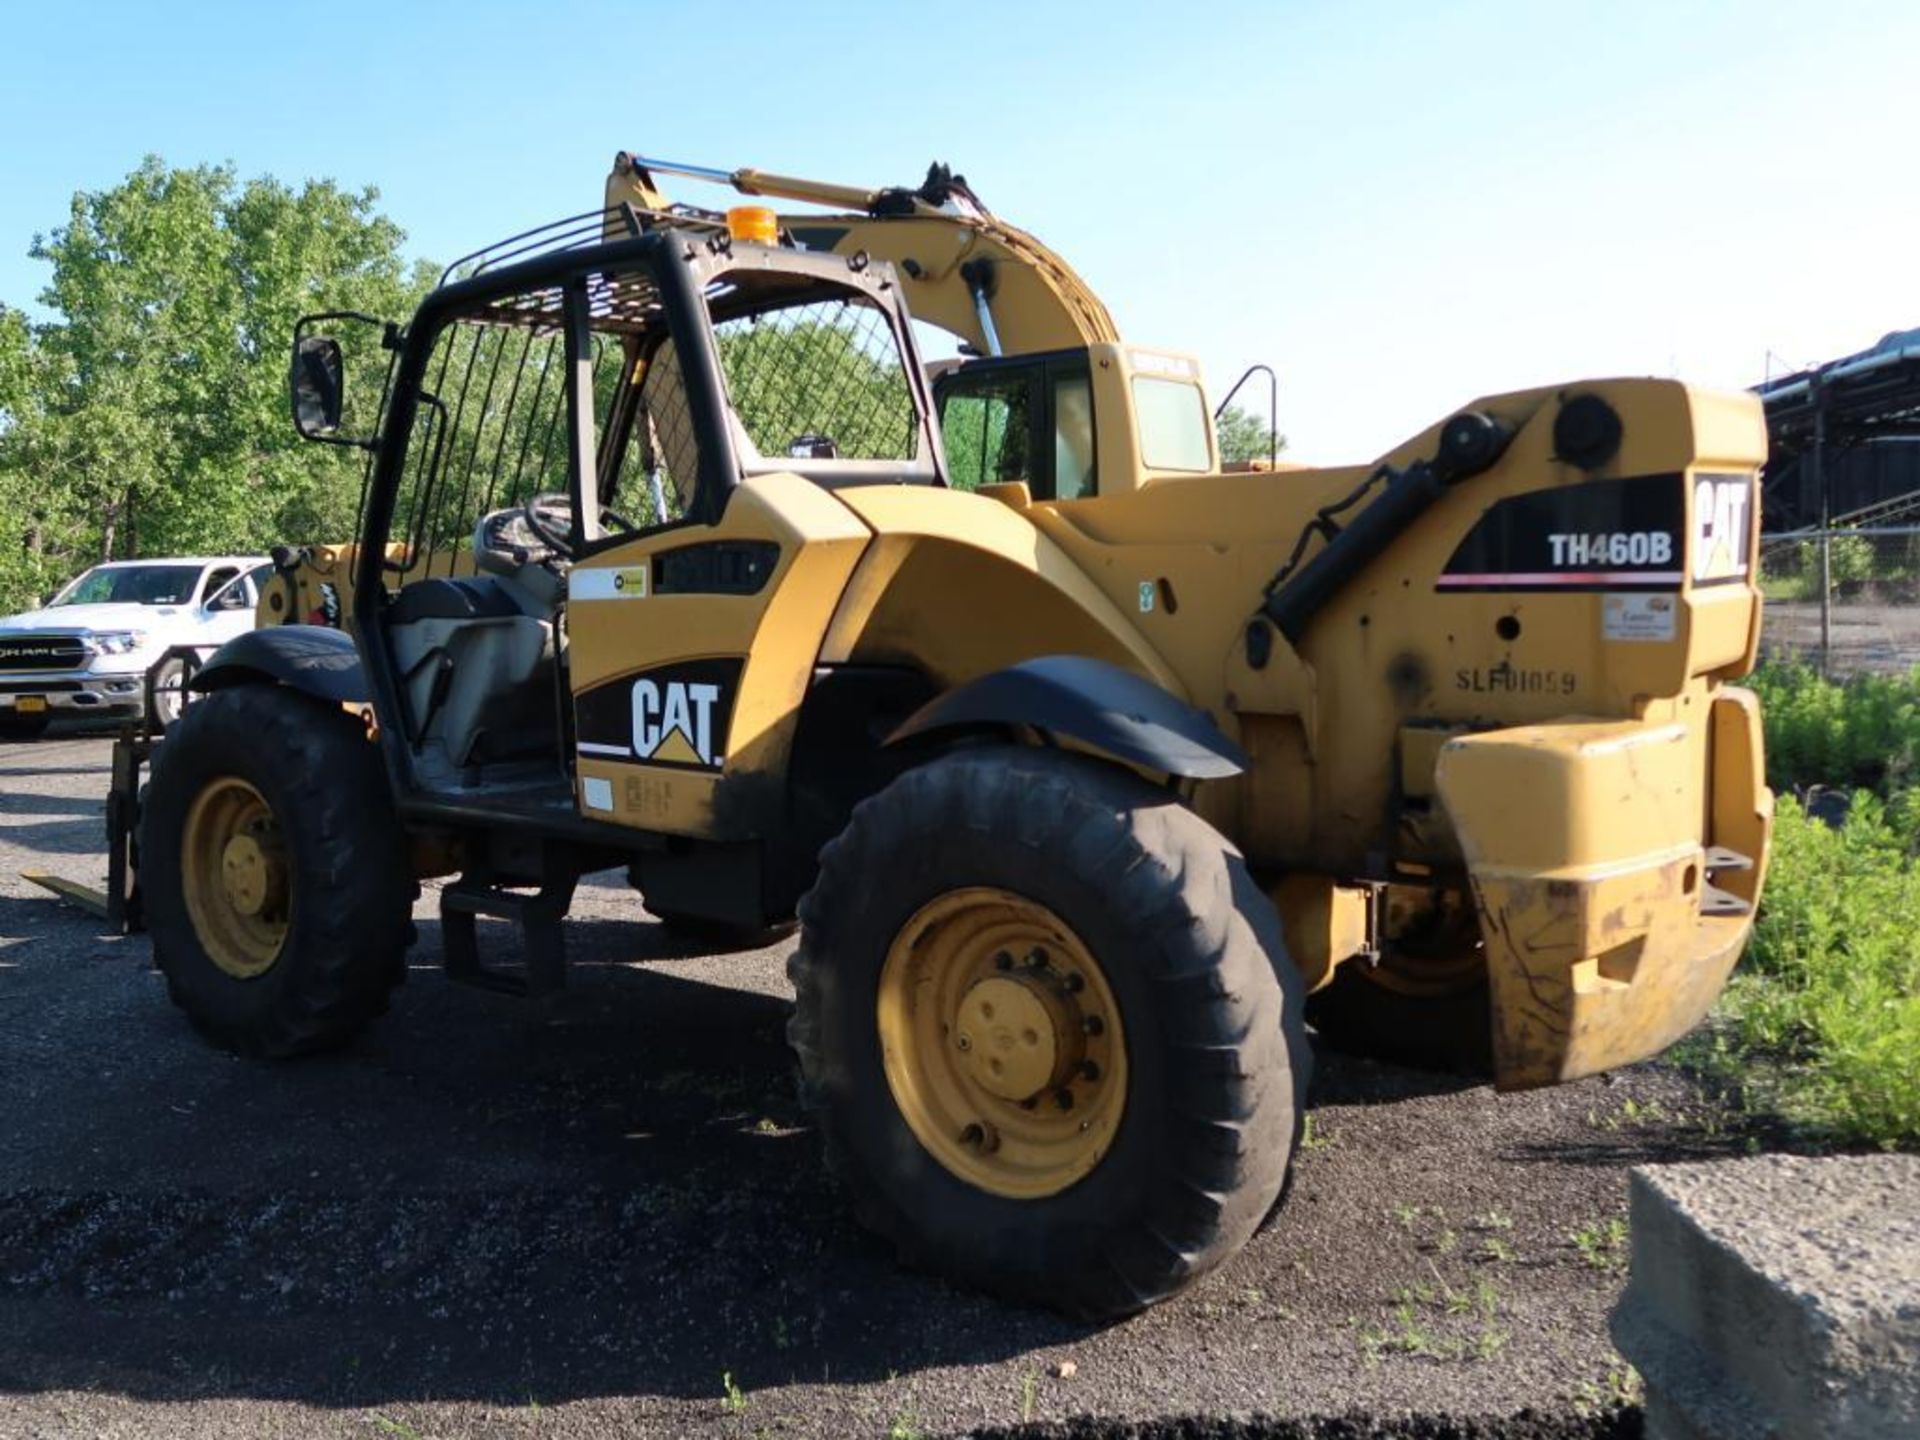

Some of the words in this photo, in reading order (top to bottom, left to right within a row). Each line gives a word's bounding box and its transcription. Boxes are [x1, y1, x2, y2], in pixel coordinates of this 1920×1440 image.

[1549, 531, 1672, 565] TH460B
[1694, 480, 1748, 580] CAT
[632, 679, 719, 765] CAT
